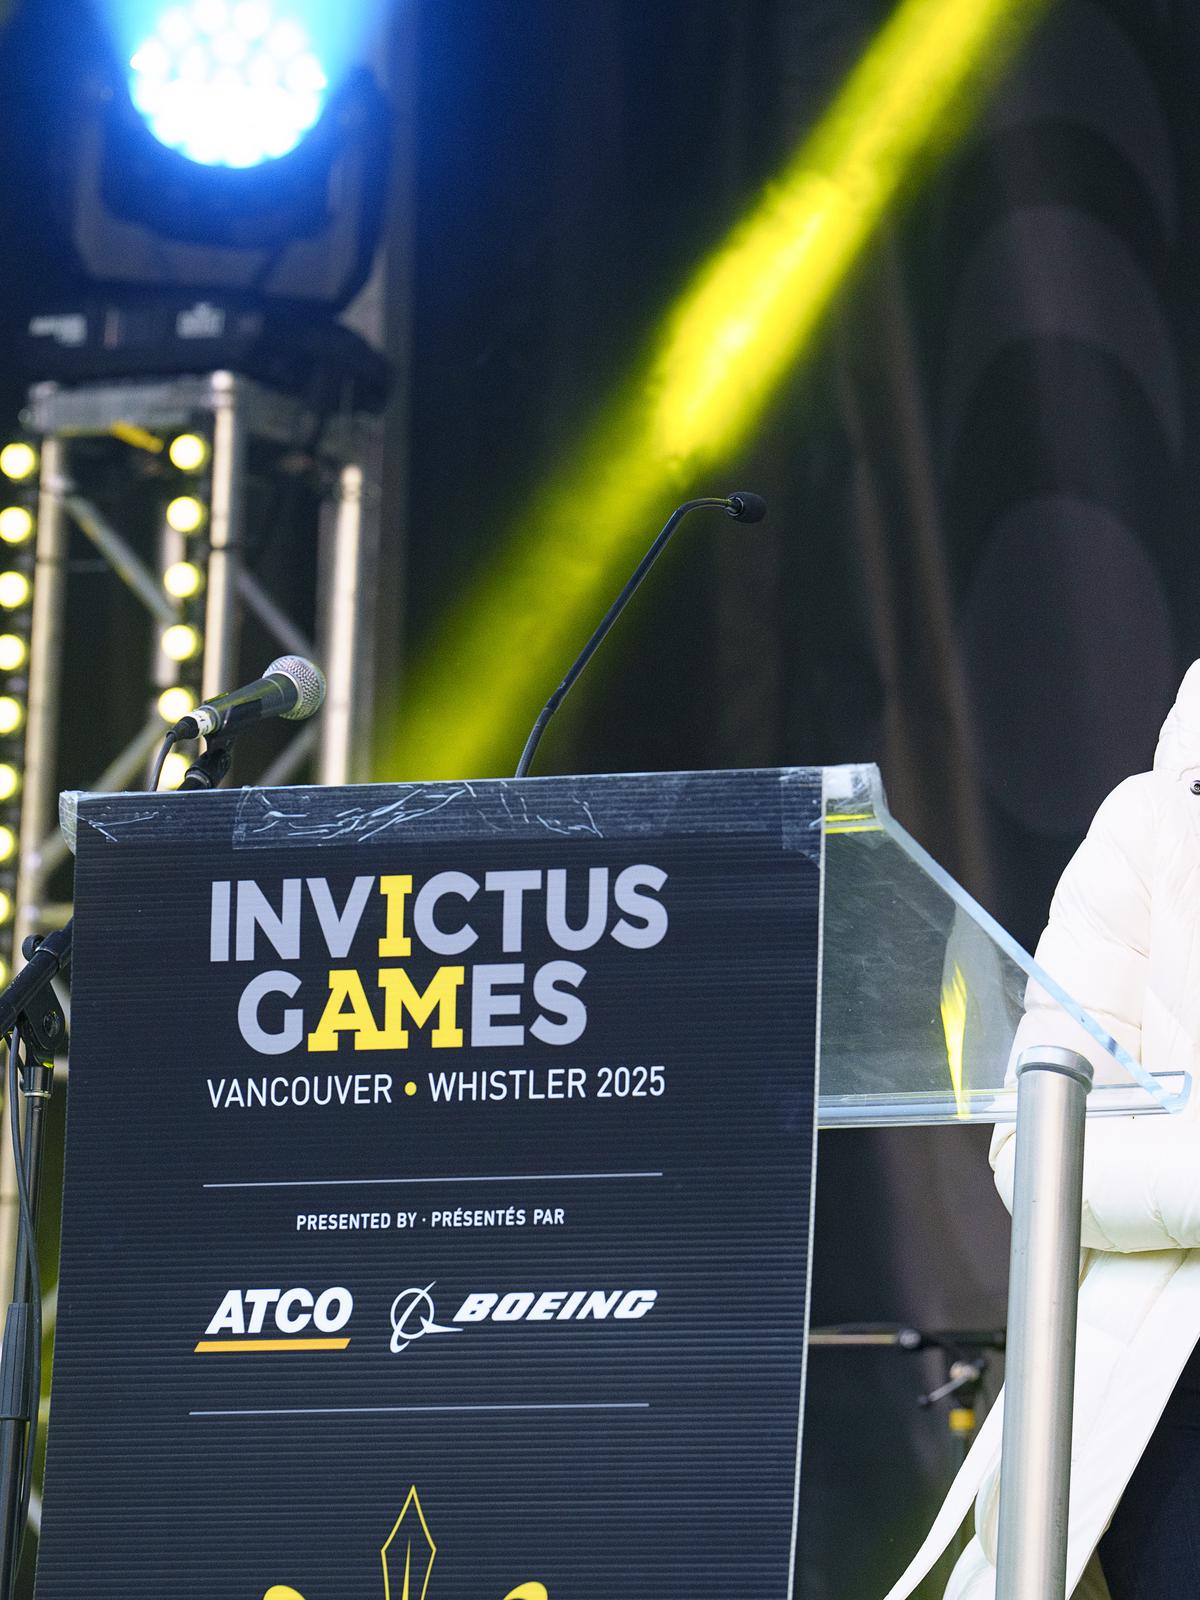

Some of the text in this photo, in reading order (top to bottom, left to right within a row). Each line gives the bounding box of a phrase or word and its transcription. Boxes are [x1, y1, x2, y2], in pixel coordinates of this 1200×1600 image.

[210, 864, 669, 962] INVICTUS
[237, 960, 588, 1055] GAMES
[206, 1065, 666, 1109] VANCOUVER WHISTLER 2025
[296, 1206, 565, 1231] PRESENTED BY PRÉSENTÉS PAR
[204, 1286, 354, 1334] ATCO
[452, 1289, 658, 1323] BOEING
